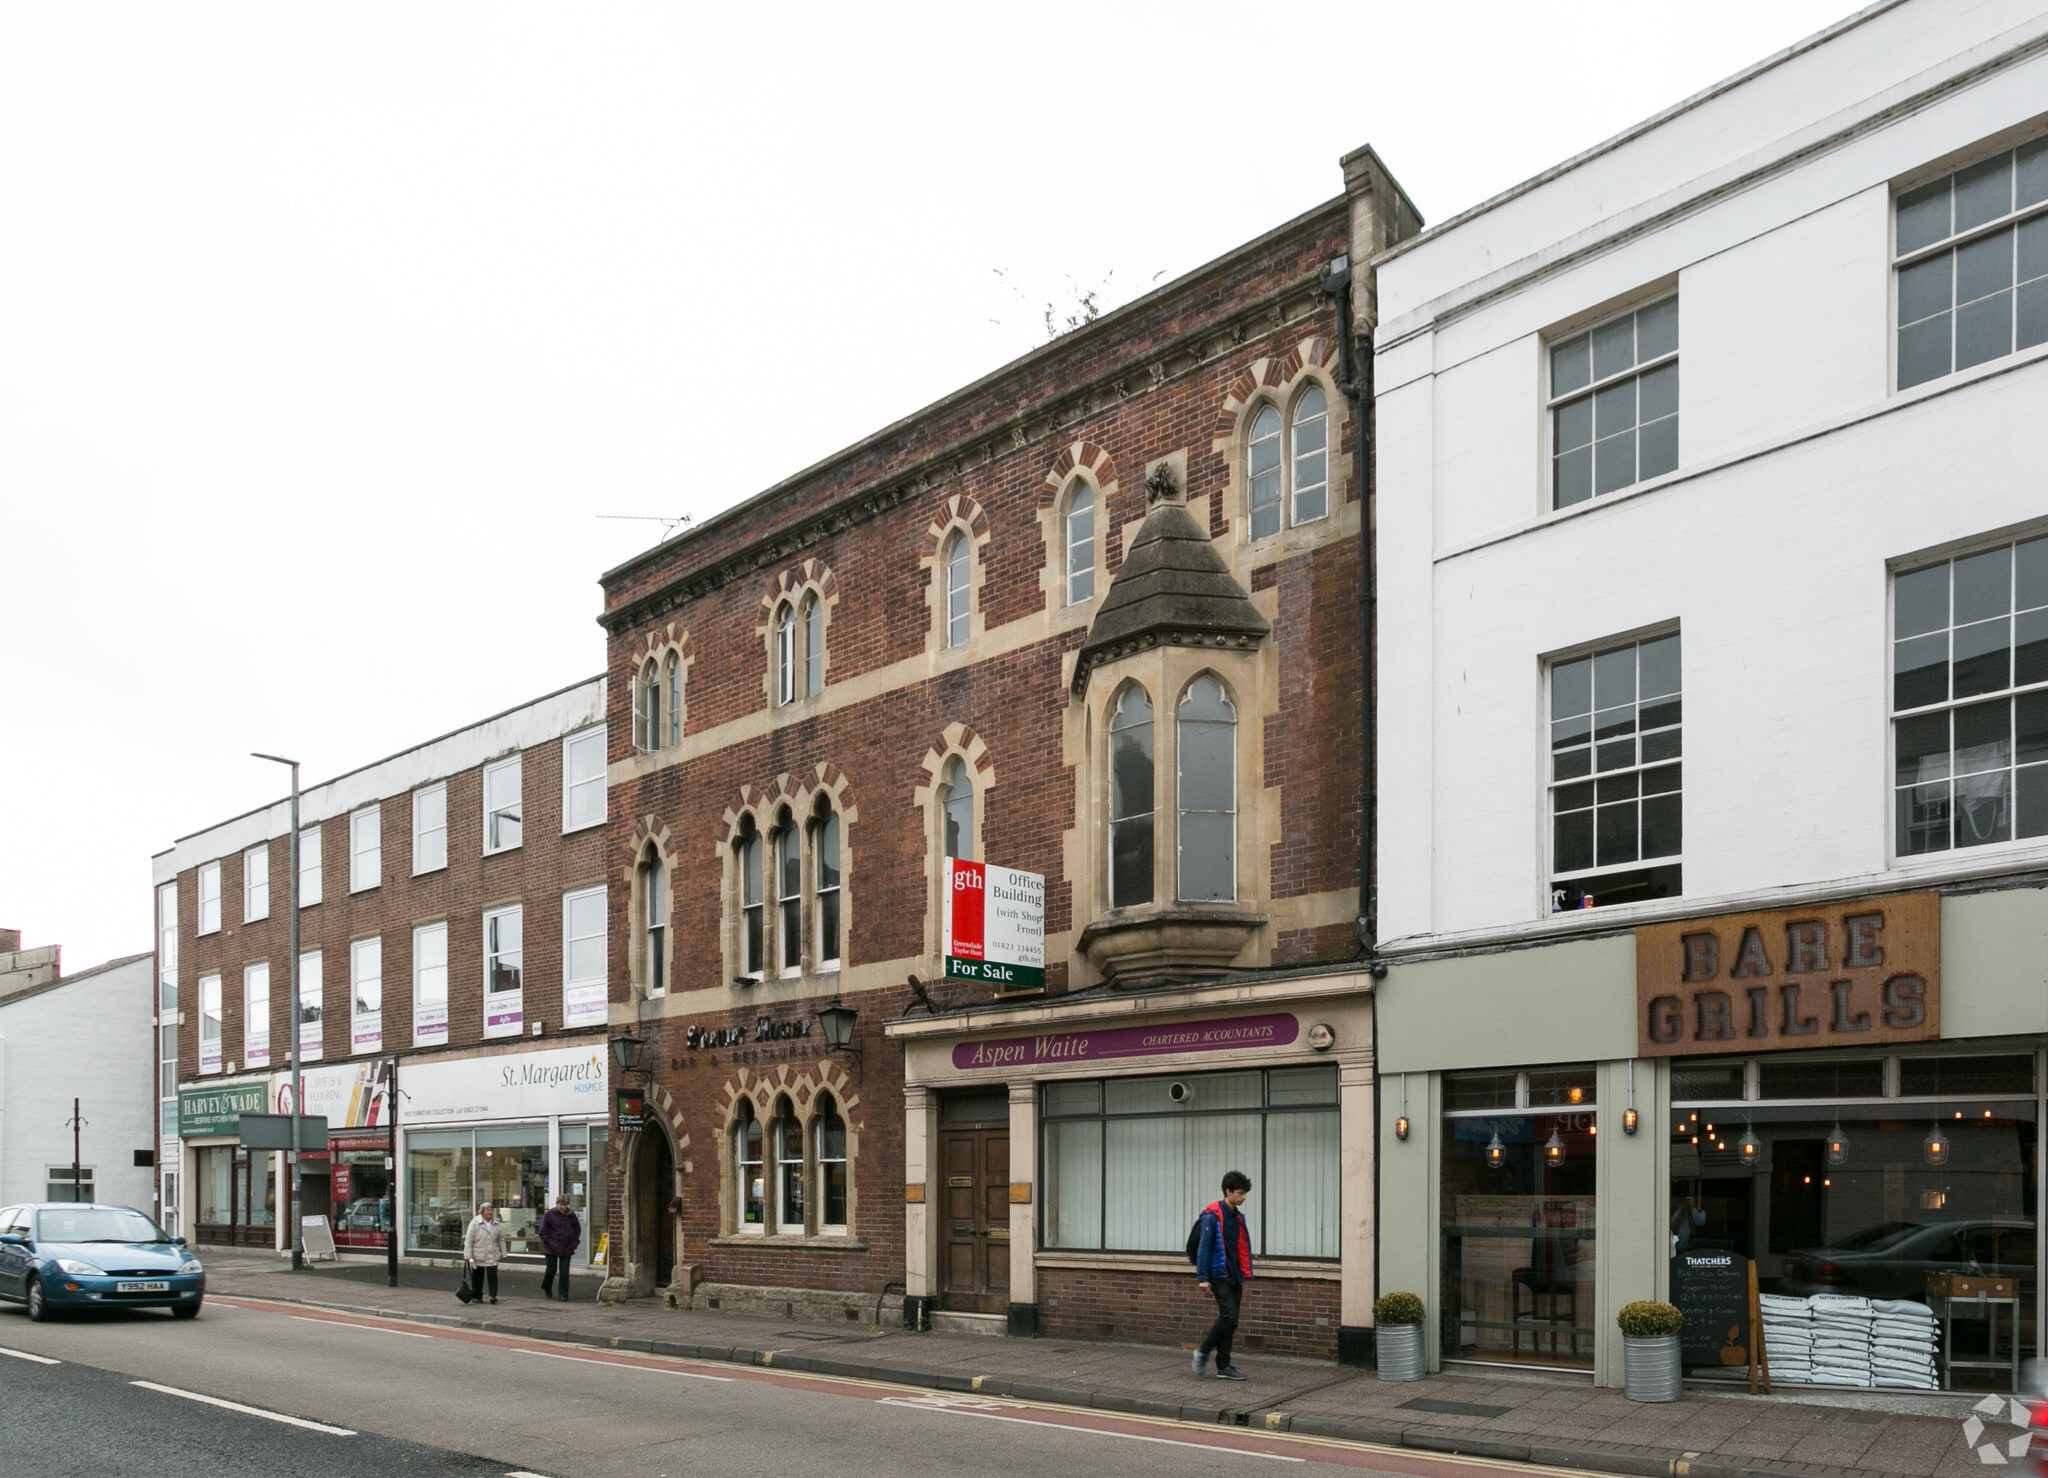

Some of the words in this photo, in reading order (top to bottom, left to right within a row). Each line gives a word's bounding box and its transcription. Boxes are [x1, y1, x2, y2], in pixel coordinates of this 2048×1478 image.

[954, 869, 983, 891] gth
[1009, 873, 1043, 890] Office
[993, 886, 1042, 908] Building
[996, 907, 1019, 919] (with
[1021, 911, 1042, 924] Shop
[1016, 924, 1042, 937] Front)
[953, 940, 982, 949] Greenslade
[954, 947, 970, 955] Taylor
[992, 941, 1014, 950] 01823
[1017, 943, 1042, 955] 334455
[1680, 909, 1885, 983] BARE
[1018, 954, 1042, 964] gth.net
[953, 960, 978, 976] For
[983, 964, 1014, 981] Sale
[1648, 971, 1926, 1044] GRILLS
[1143, 1032, 1199, 1046] CHARTERED
[1202, 1026, 1273, 1041] ACCOUNTANTS
[971, 1042, 1026, 1067] Aspen
[1034, 1035, 1089, 1059] Waite
[501, 1065, 518, 1088] St.
[520, 1057, 603, 1088] Margaret's
[310, 1077, 336, 1089] CARPETS
[574, 1082, 603, 1093] HOSPICE
[184, 1096, 221, 1115] HARVEY
[230, 1092, 260, 1112] WADE
[310, 1089, 343, 1102] FLOORING
[1685, 1256, 1732, 1265] THATCHERS
[121, 1282, 145, 1290] Y992
